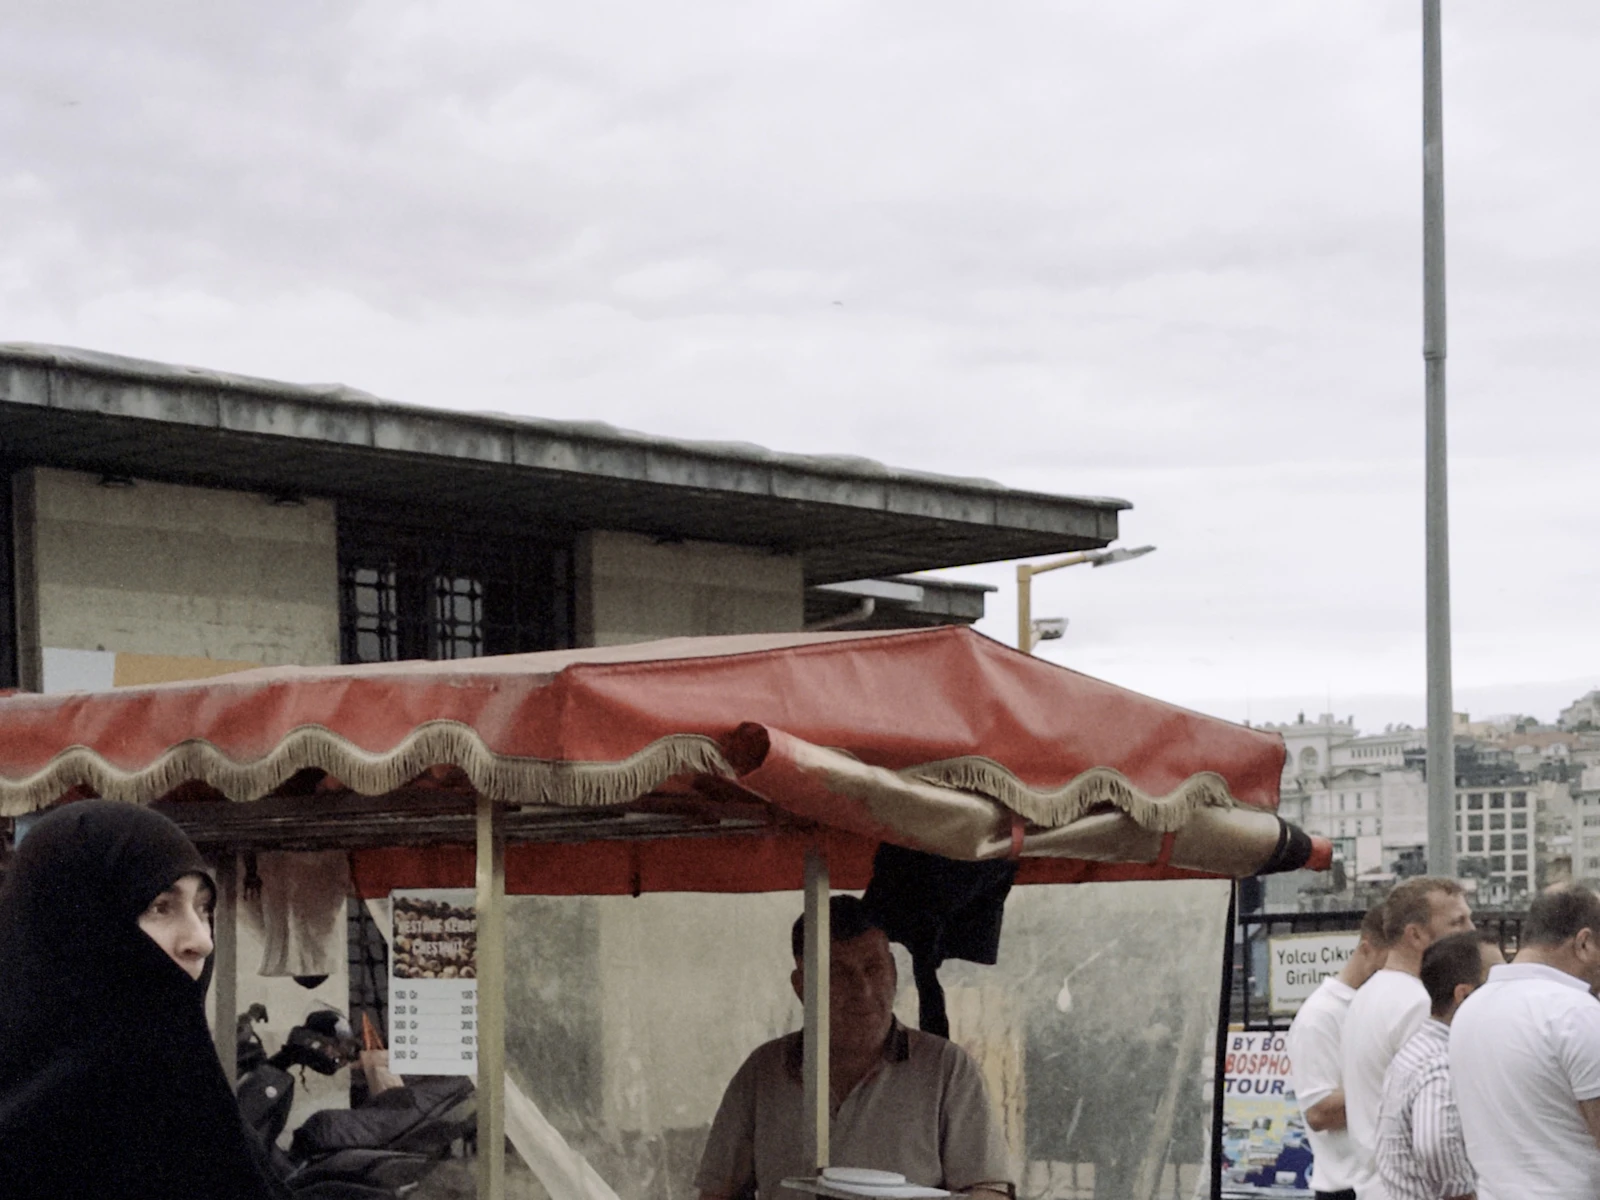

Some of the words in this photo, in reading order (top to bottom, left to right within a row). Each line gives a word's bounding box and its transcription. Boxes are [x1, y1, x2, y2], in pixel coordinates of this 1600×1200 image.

[1277, 949, 1317, 965] Yolcu
[1232, 1037, 1256, 1051] BY
[1261, 1037, 1287, 1052] BO
[1224, 1053, 1293, 1075] BOSPHO
[1225, 1078, 1285, 1095] TOUR
